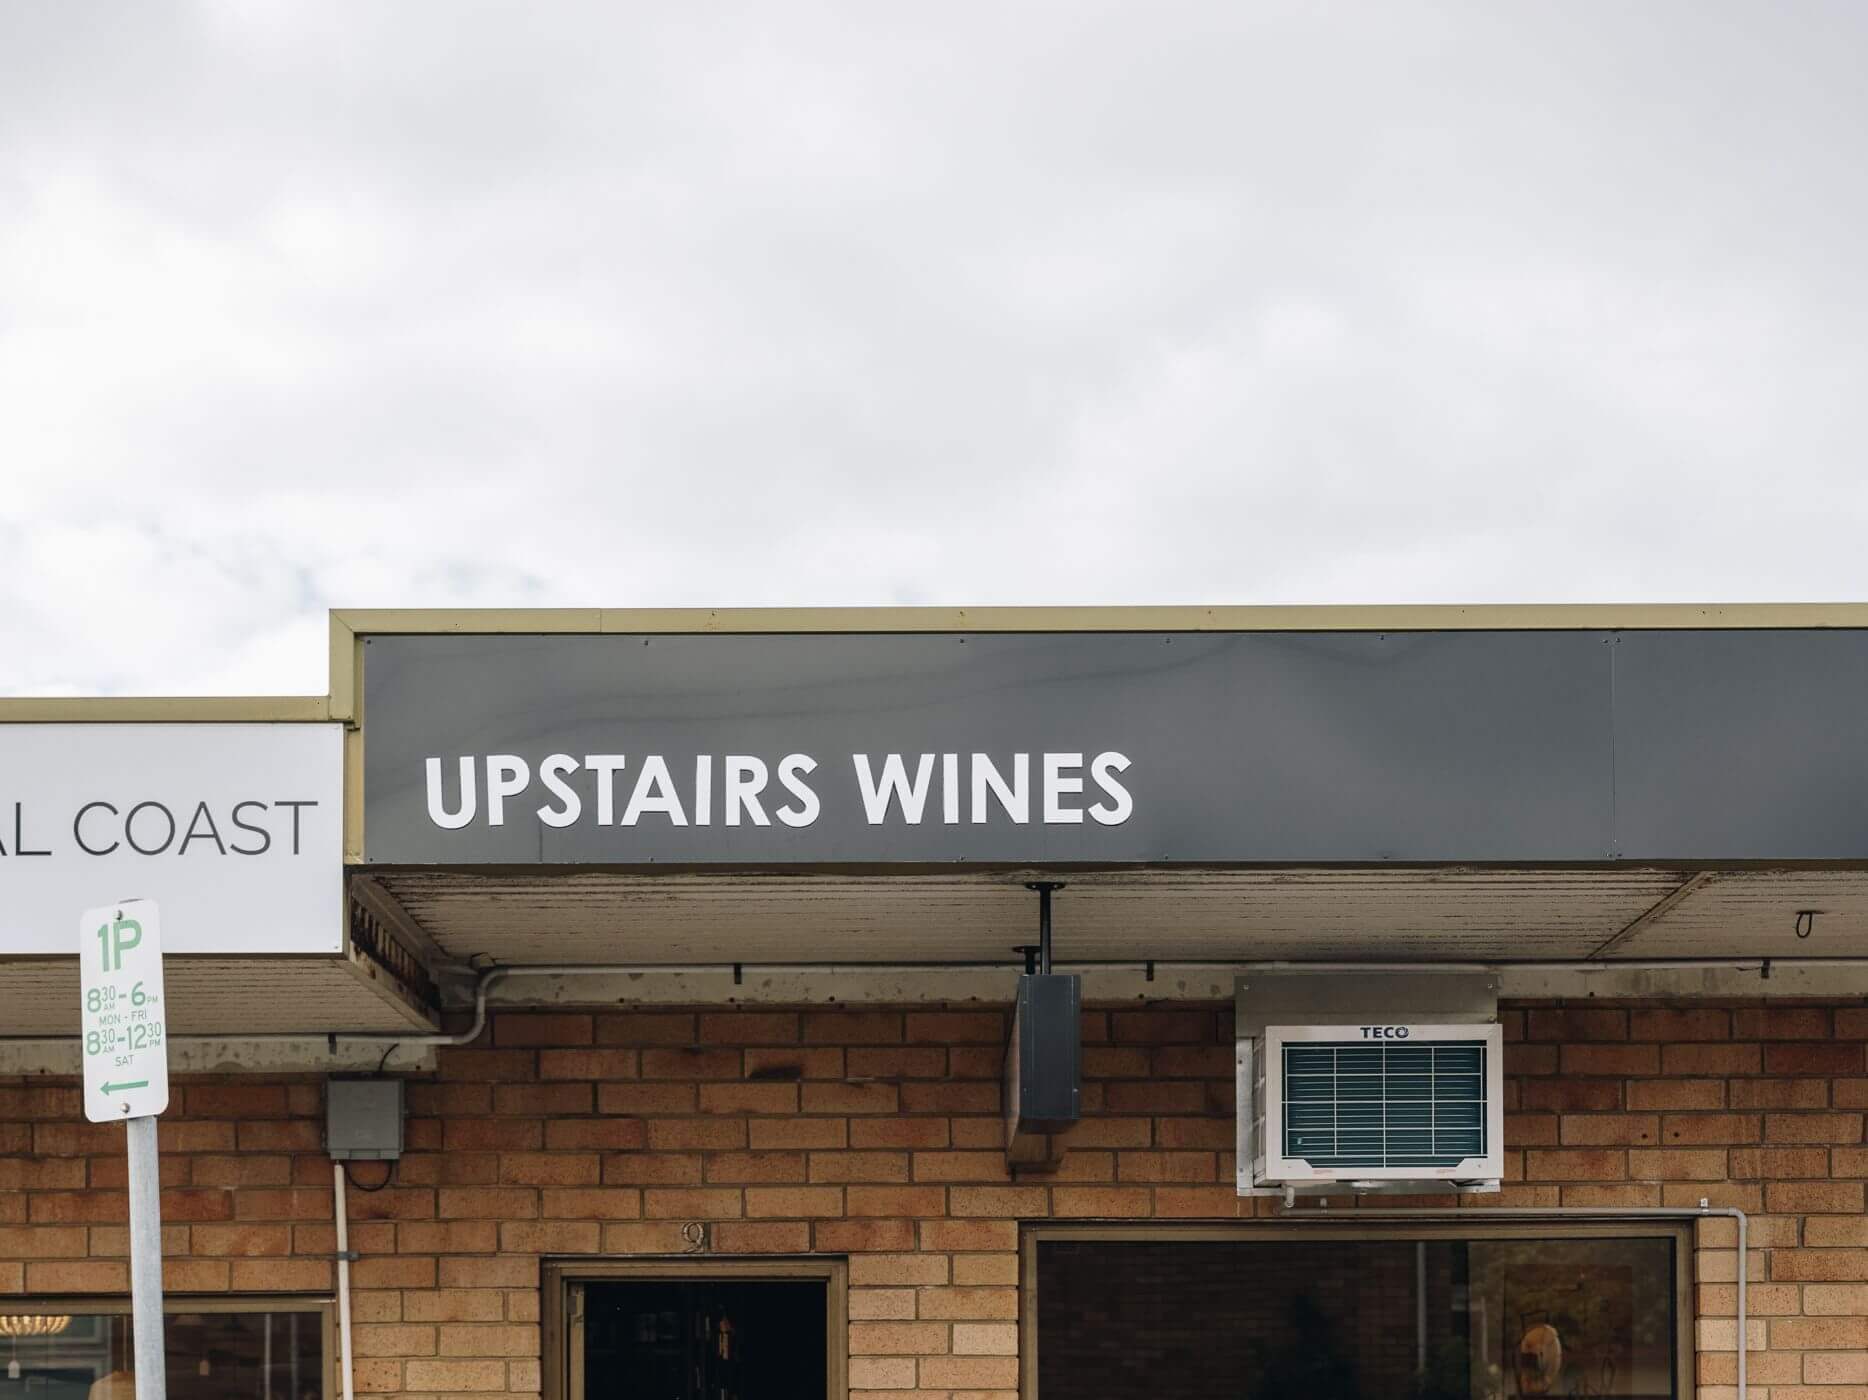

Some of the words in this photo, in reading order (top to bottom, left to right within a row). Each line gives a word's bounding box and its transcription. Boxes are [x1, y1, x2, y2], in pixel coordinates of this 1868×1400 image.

[425, 752, 821, 830] UPSTAIRS
[852, 751, 1134, 827] WINES
[73, 800, 318, 856] COAST
[97, 919, 142, 972] 1P
[99, 1014, 121, 1026] MON
[131, 1009, 148, 1021] FRI
[1360, 1026, 1409, 1039] TECO
[115, 1055, 134, 1067] SAT
[683, 1222, 704, 1253] 9
